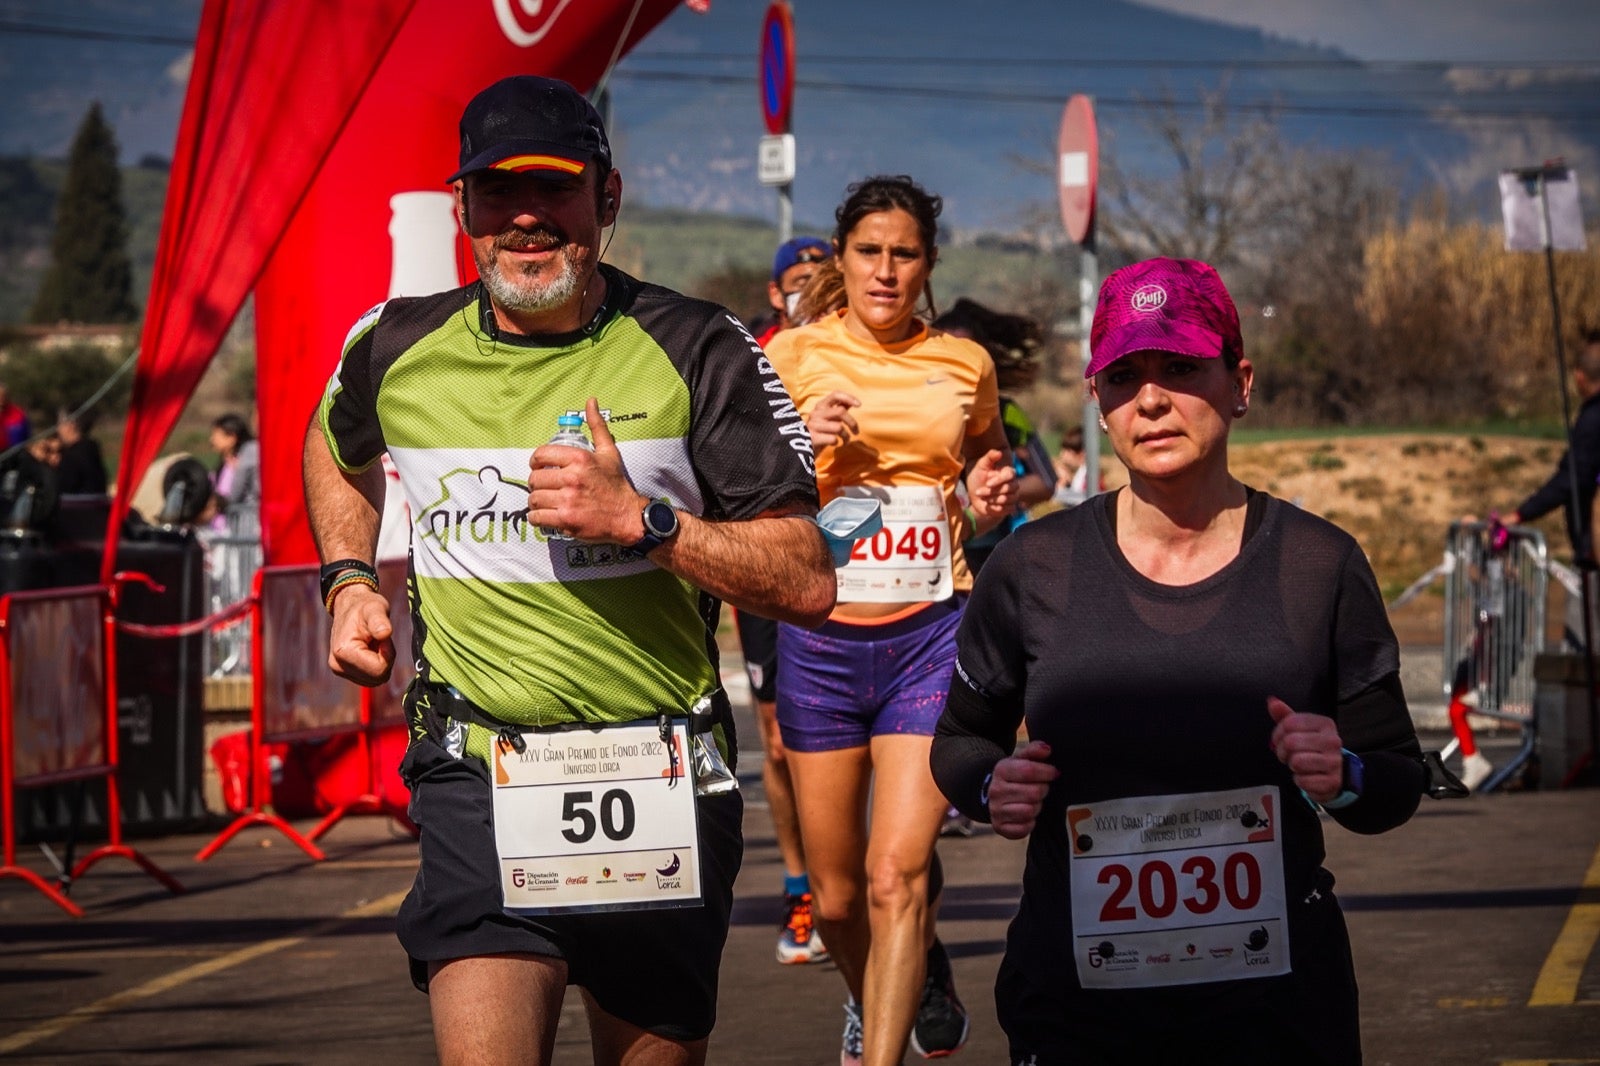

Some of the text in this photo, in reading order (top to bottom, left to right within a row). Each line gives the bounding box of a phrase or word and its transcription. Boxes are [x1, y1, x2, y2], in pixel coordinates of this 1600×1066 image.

[610, 412, 648, 423] CYCLING
[850, 526, 941, 561] 2049
[641, 742, 663, 756] 2022
[561, 788, 636, 844] 50
[1097, 851, 1262, 922] 2030
